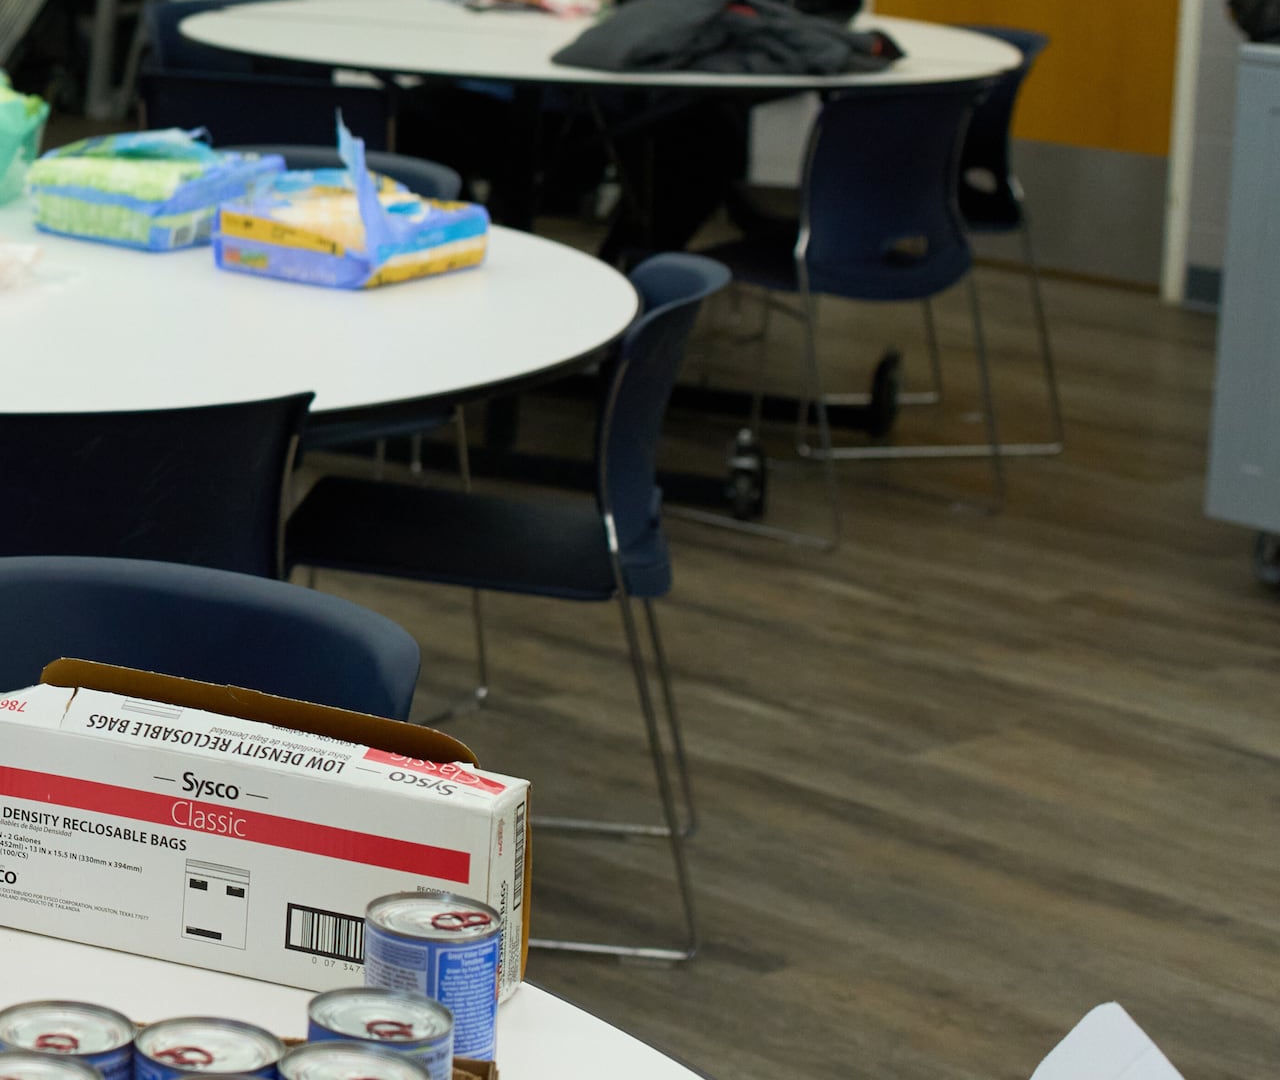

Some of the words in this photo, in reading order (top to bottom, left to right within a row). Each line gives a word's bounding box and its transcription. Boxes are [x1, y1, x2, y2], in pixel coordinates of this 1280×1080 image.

[86, 714, 131, 734] BAGS
[131, 721, 232, 752] RECLOSABLE
[232, 741, 304, 766] DENSITY
[305, 755, 347, 774] LOW
[182, 772, 239, 800] Sysco
[389, 771, 458, 796] Sysco
[3, 806, 60, 827] DENSITY
[63, 817, 148, 844] RECLOSABLE
[151, 833, 187, 851] BAGS
[29, 823, 43, 832] Baja
[171, 801, 247, 837] Classic
[13, 835, 41, 845] Galones
[0, 848, 29, 860] (100/CS)
[30, 845, 38, 853] 13
[39, 847, 47, 855] IN
[54, 850, 68, 859] 15.5
[69, 852, 77, 860] IN
[78, 854, 107, 867] (330mm
[113, 861, 143, 874] 394mm)
[324, 959, 336, 968] 07
